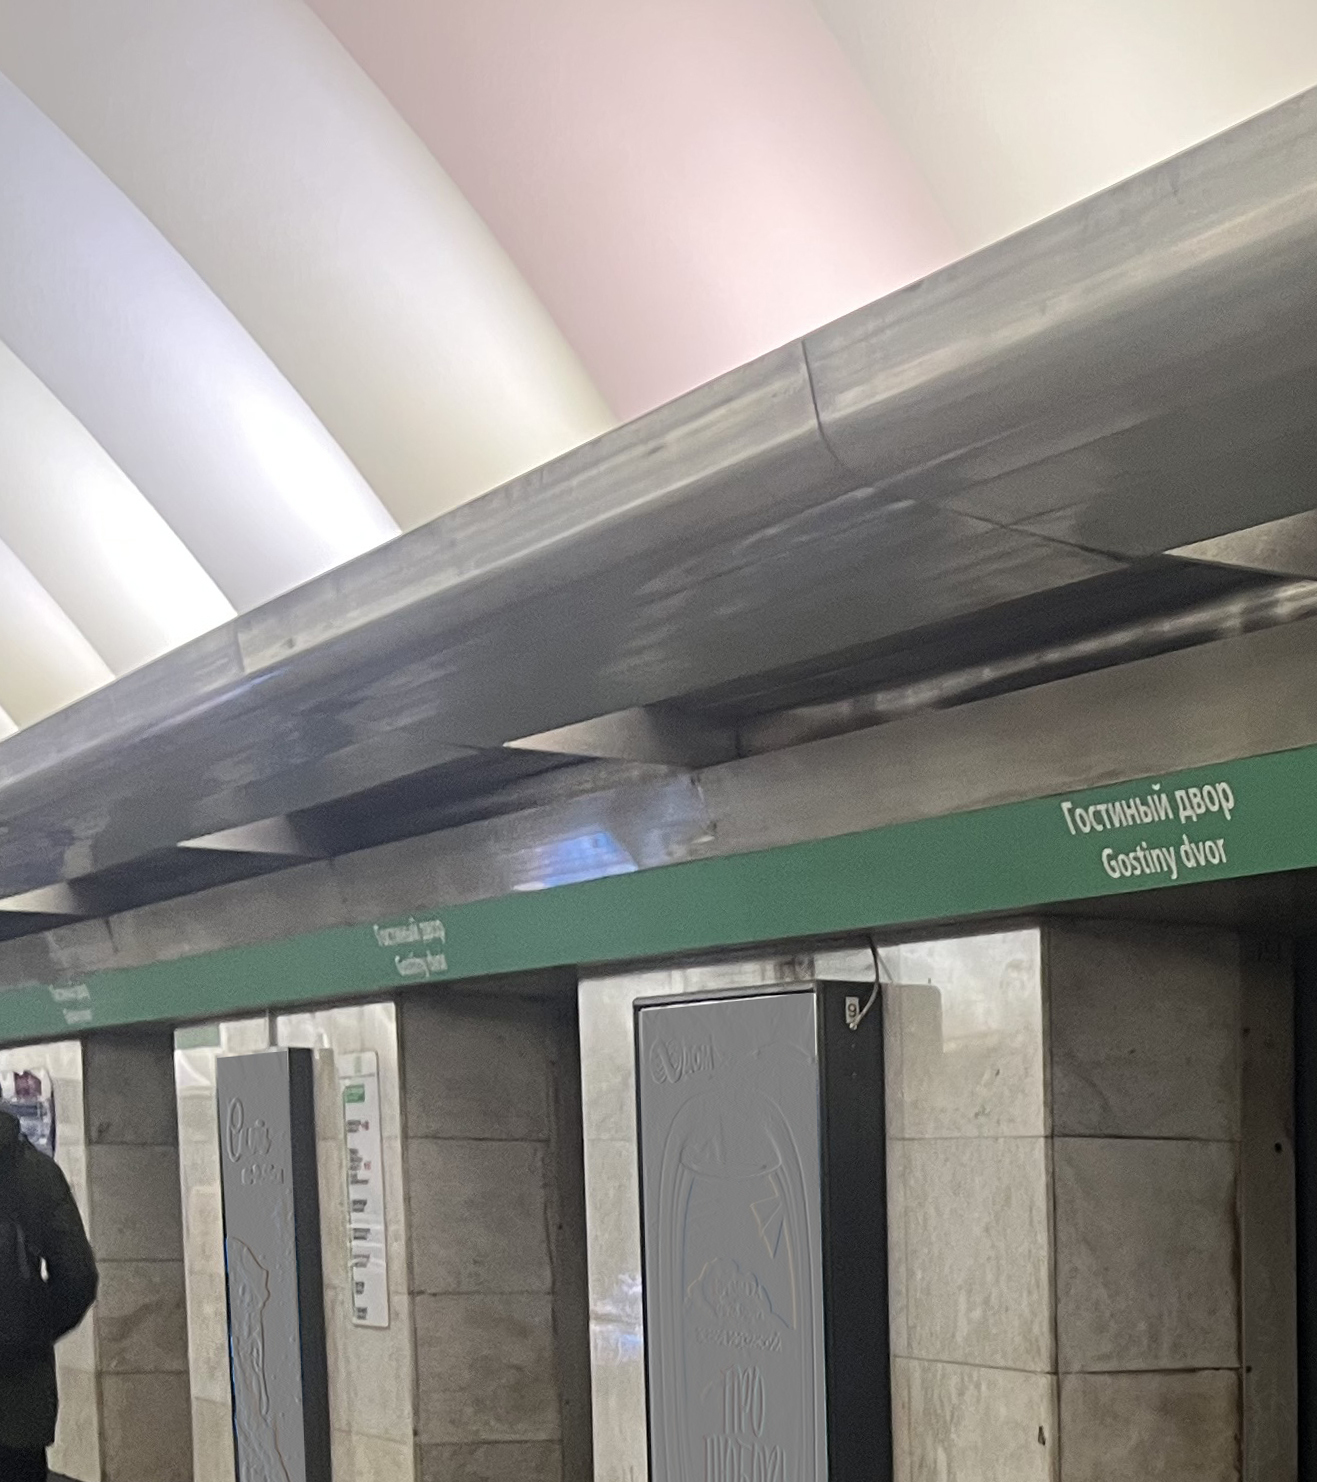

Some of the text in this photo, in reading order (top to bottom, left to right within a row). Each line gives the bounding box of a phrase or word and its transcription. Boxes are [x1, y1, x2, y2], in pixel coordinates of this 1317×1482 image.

[1061, 781, 1235, 835] Гостиный двор
[1101, 833, 1228, 880] Gostiny dvor
